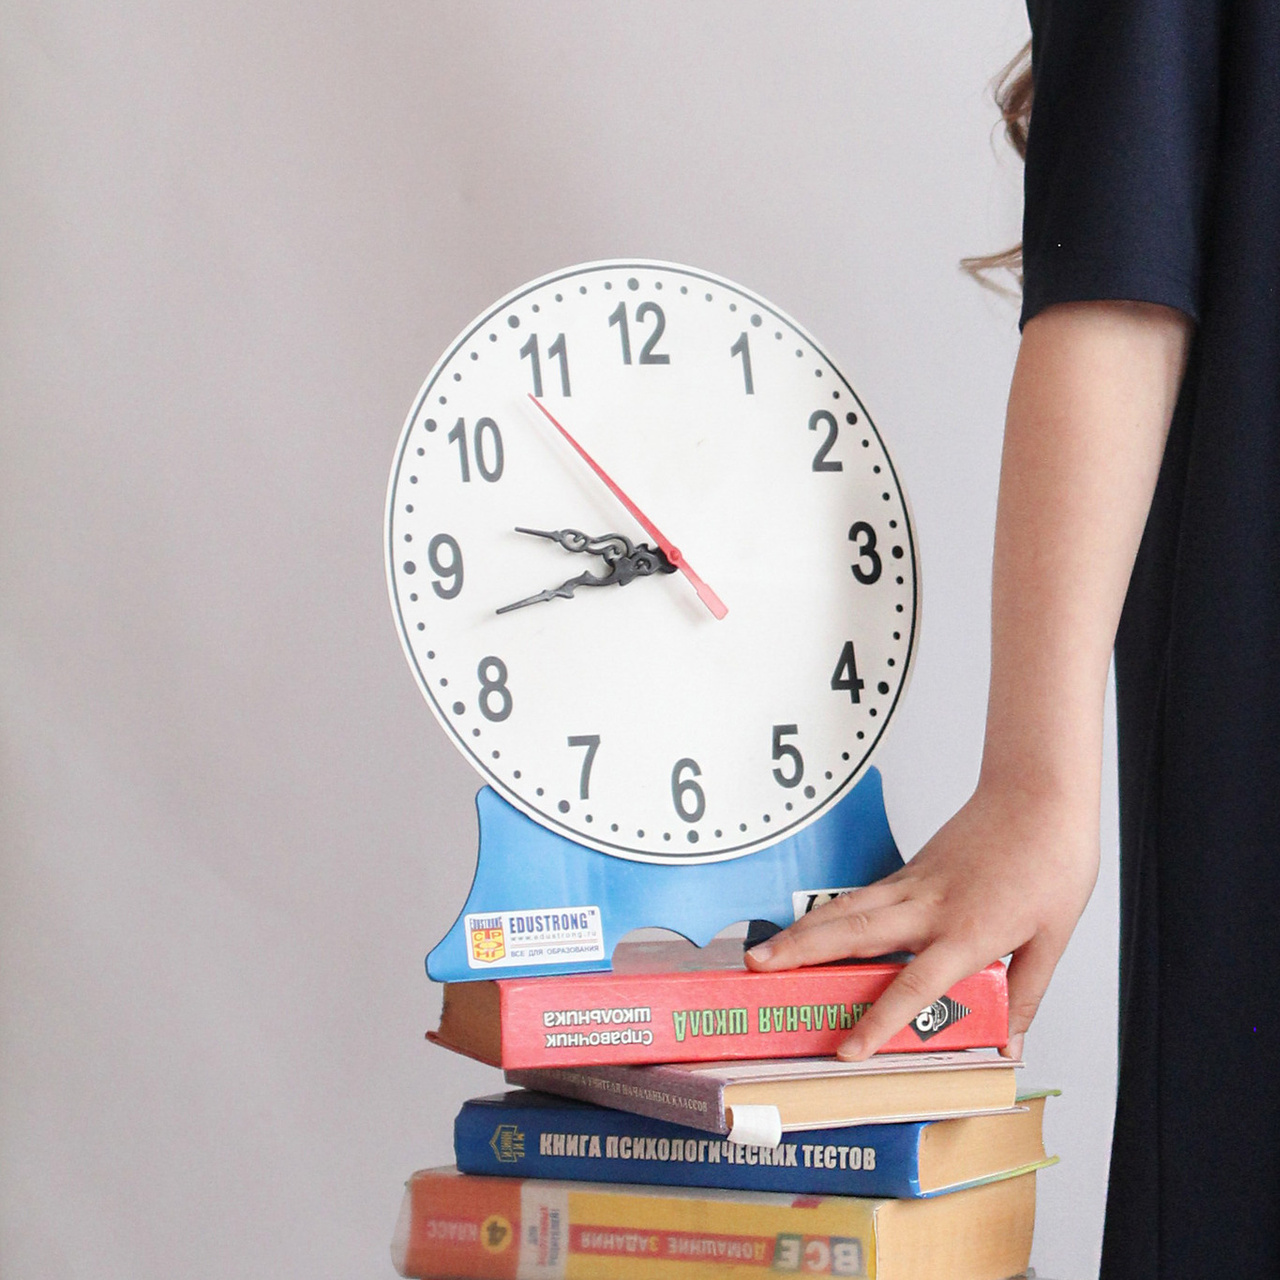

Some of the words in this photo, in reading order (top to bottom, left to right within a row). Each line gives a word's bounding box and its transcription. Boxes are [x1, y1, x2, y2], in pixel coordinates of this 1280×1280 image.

[519, 332, 572, 397] 11
[608, 301, 670, 365] 12
[730, 331, 755, 395] 1
[448, 417, 505, 483] 10
[808, 409, 843, 472] 2
[428, 533, 464, 600] 9
[848, 521, 883, 585] 3
[477, 656, 513, 723] 8
[831, 641, 865, 704] 4
[567, 734, 602, 800] 7
[771, 723, 804, 789] 5
[671, 758, 706, 823] 6
[547, 945, 599, 956] ОБРАЗОВАНИЯ
[543, 1007, 651, 1027] школьника
[545, 1029, 653, 1048] Справочник
[672, 1008, 748, 1042] ШКОЛА
[757, 1002, 874, 1036] АЧАЛЬНАЯ
[539, 1131, 601, 1159] КНИГА
[605, 1132, 798, 1168] ПСИХОЛОГИЧЕСКИХ
[803, 1139, 876, 1172] ТЕСТОВ
[427, 1220, 478, 1241] КЛАСС
[581, 1232, 659, 1255] ЗАДАНИЯ
[668, 1237, 766, 1261] ДОМАШНИЕ
